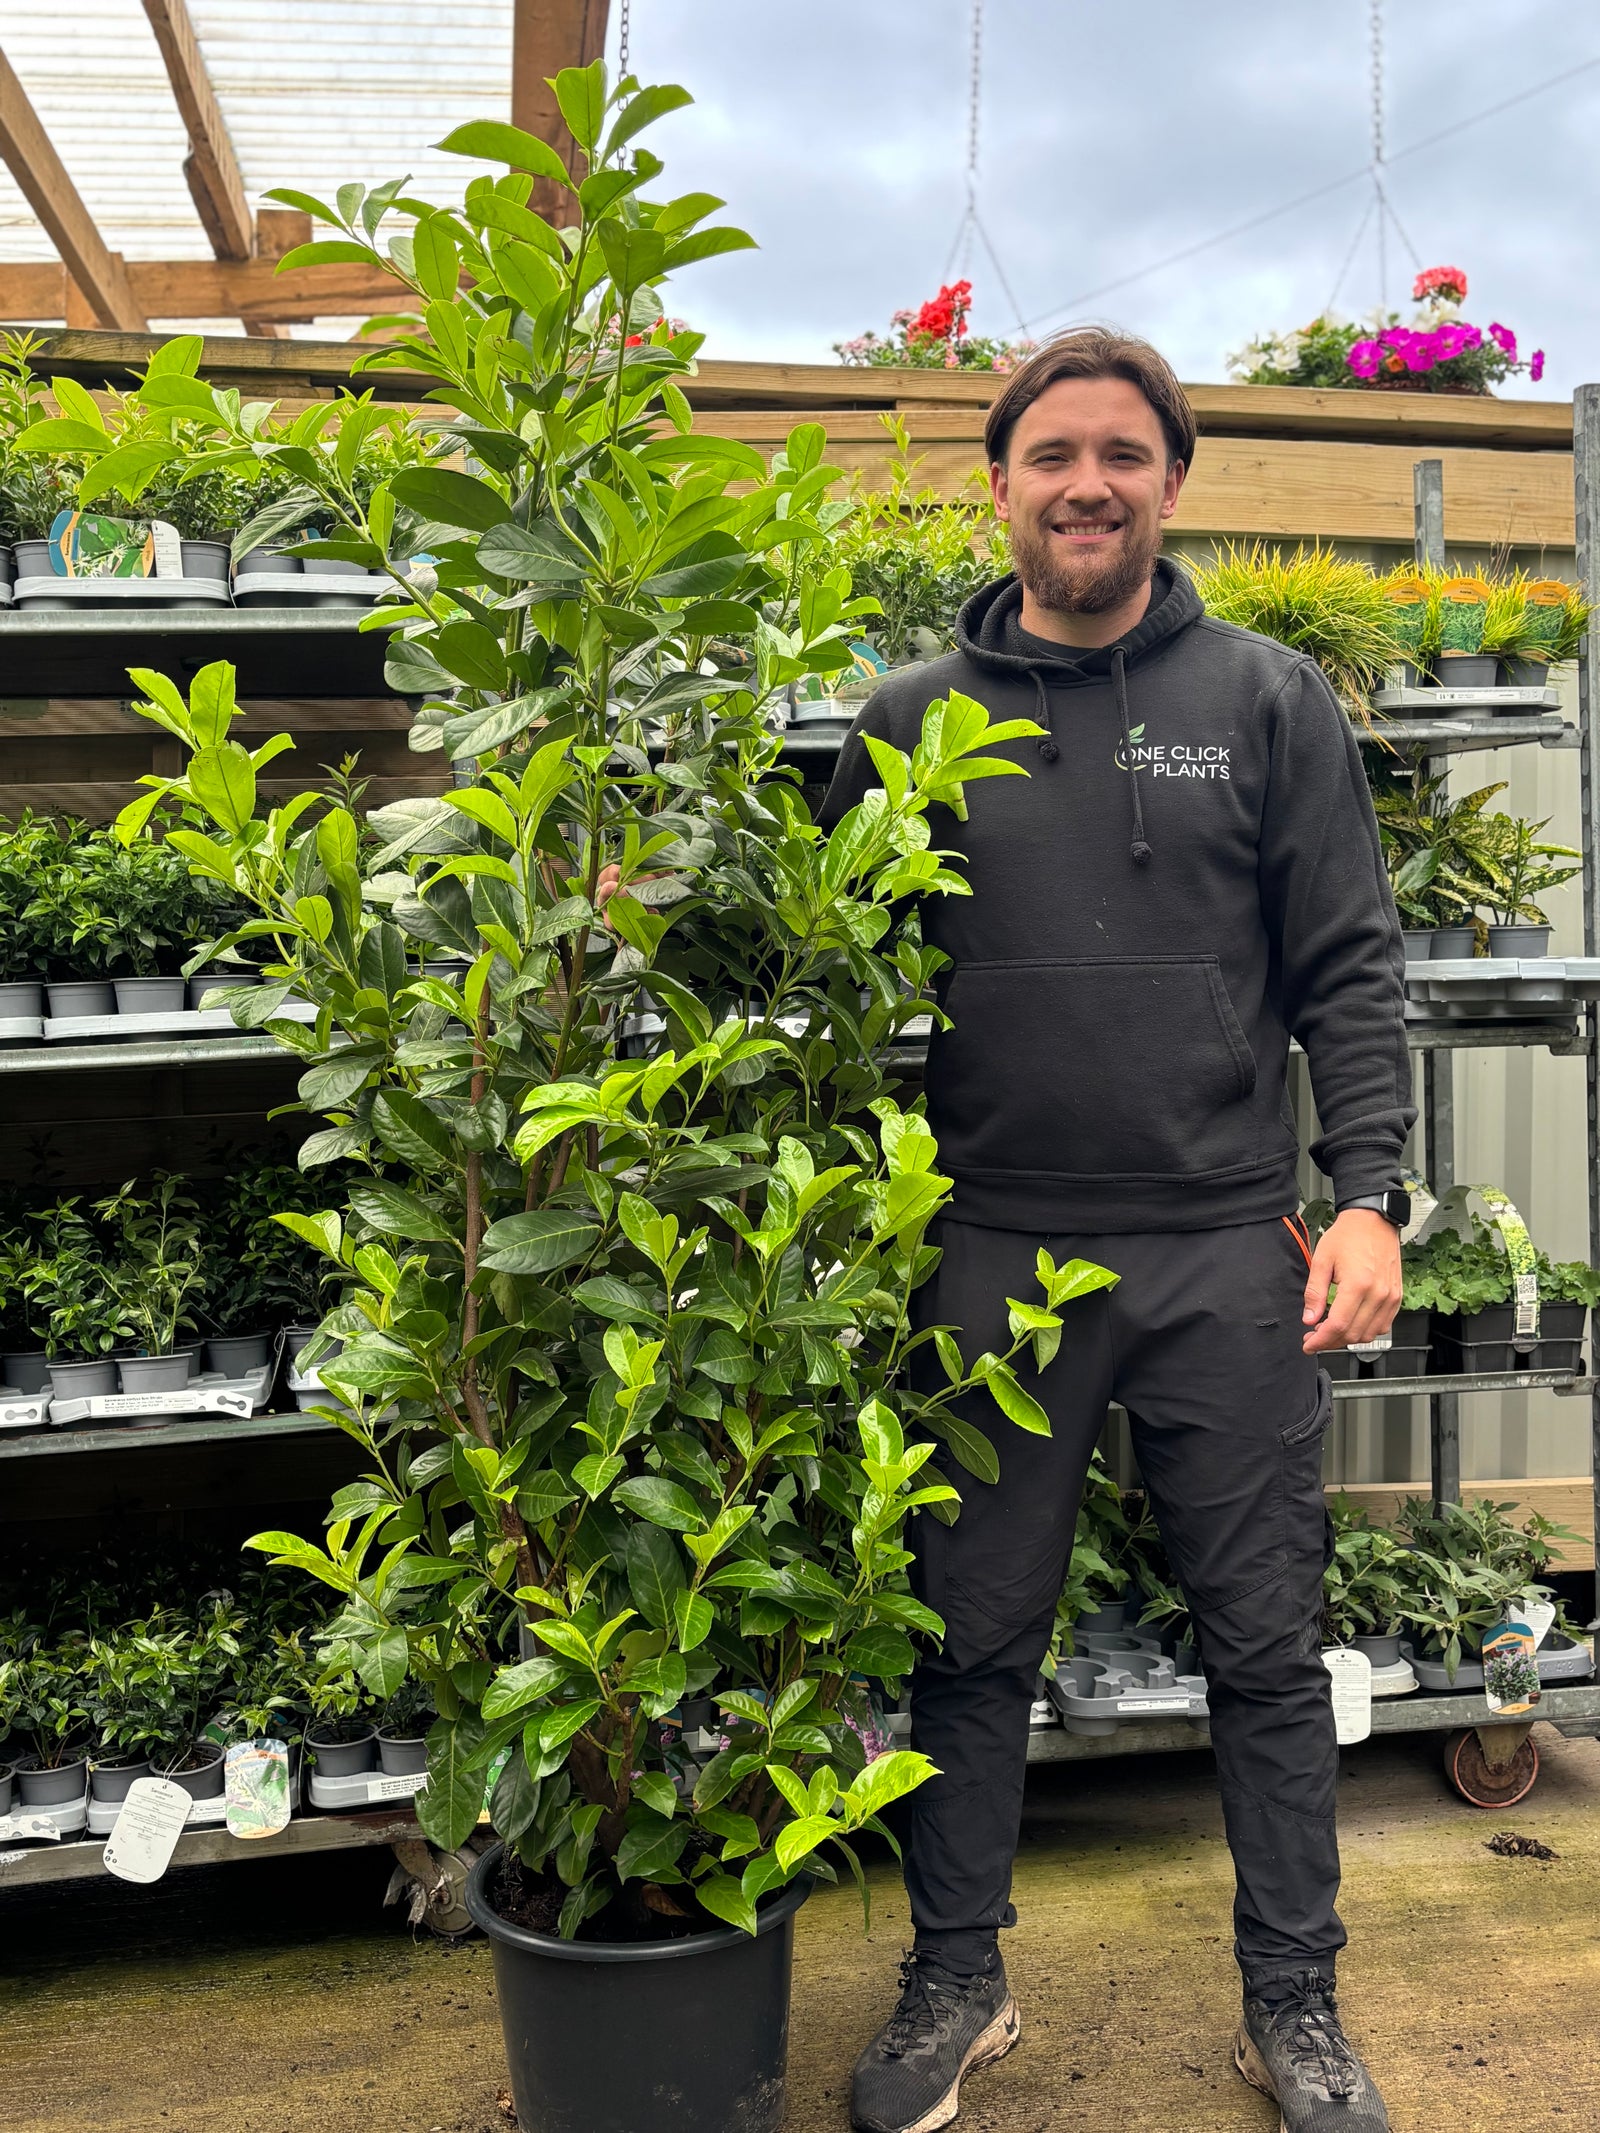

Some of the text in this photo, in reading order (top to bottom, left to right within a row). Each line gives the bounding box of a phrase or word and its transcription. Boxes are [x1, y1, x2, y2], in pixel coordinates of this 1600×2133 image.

[1121, 745, 1230, 763] ONE CLICK
[1153, 762, 1230, 780] PLANTS
